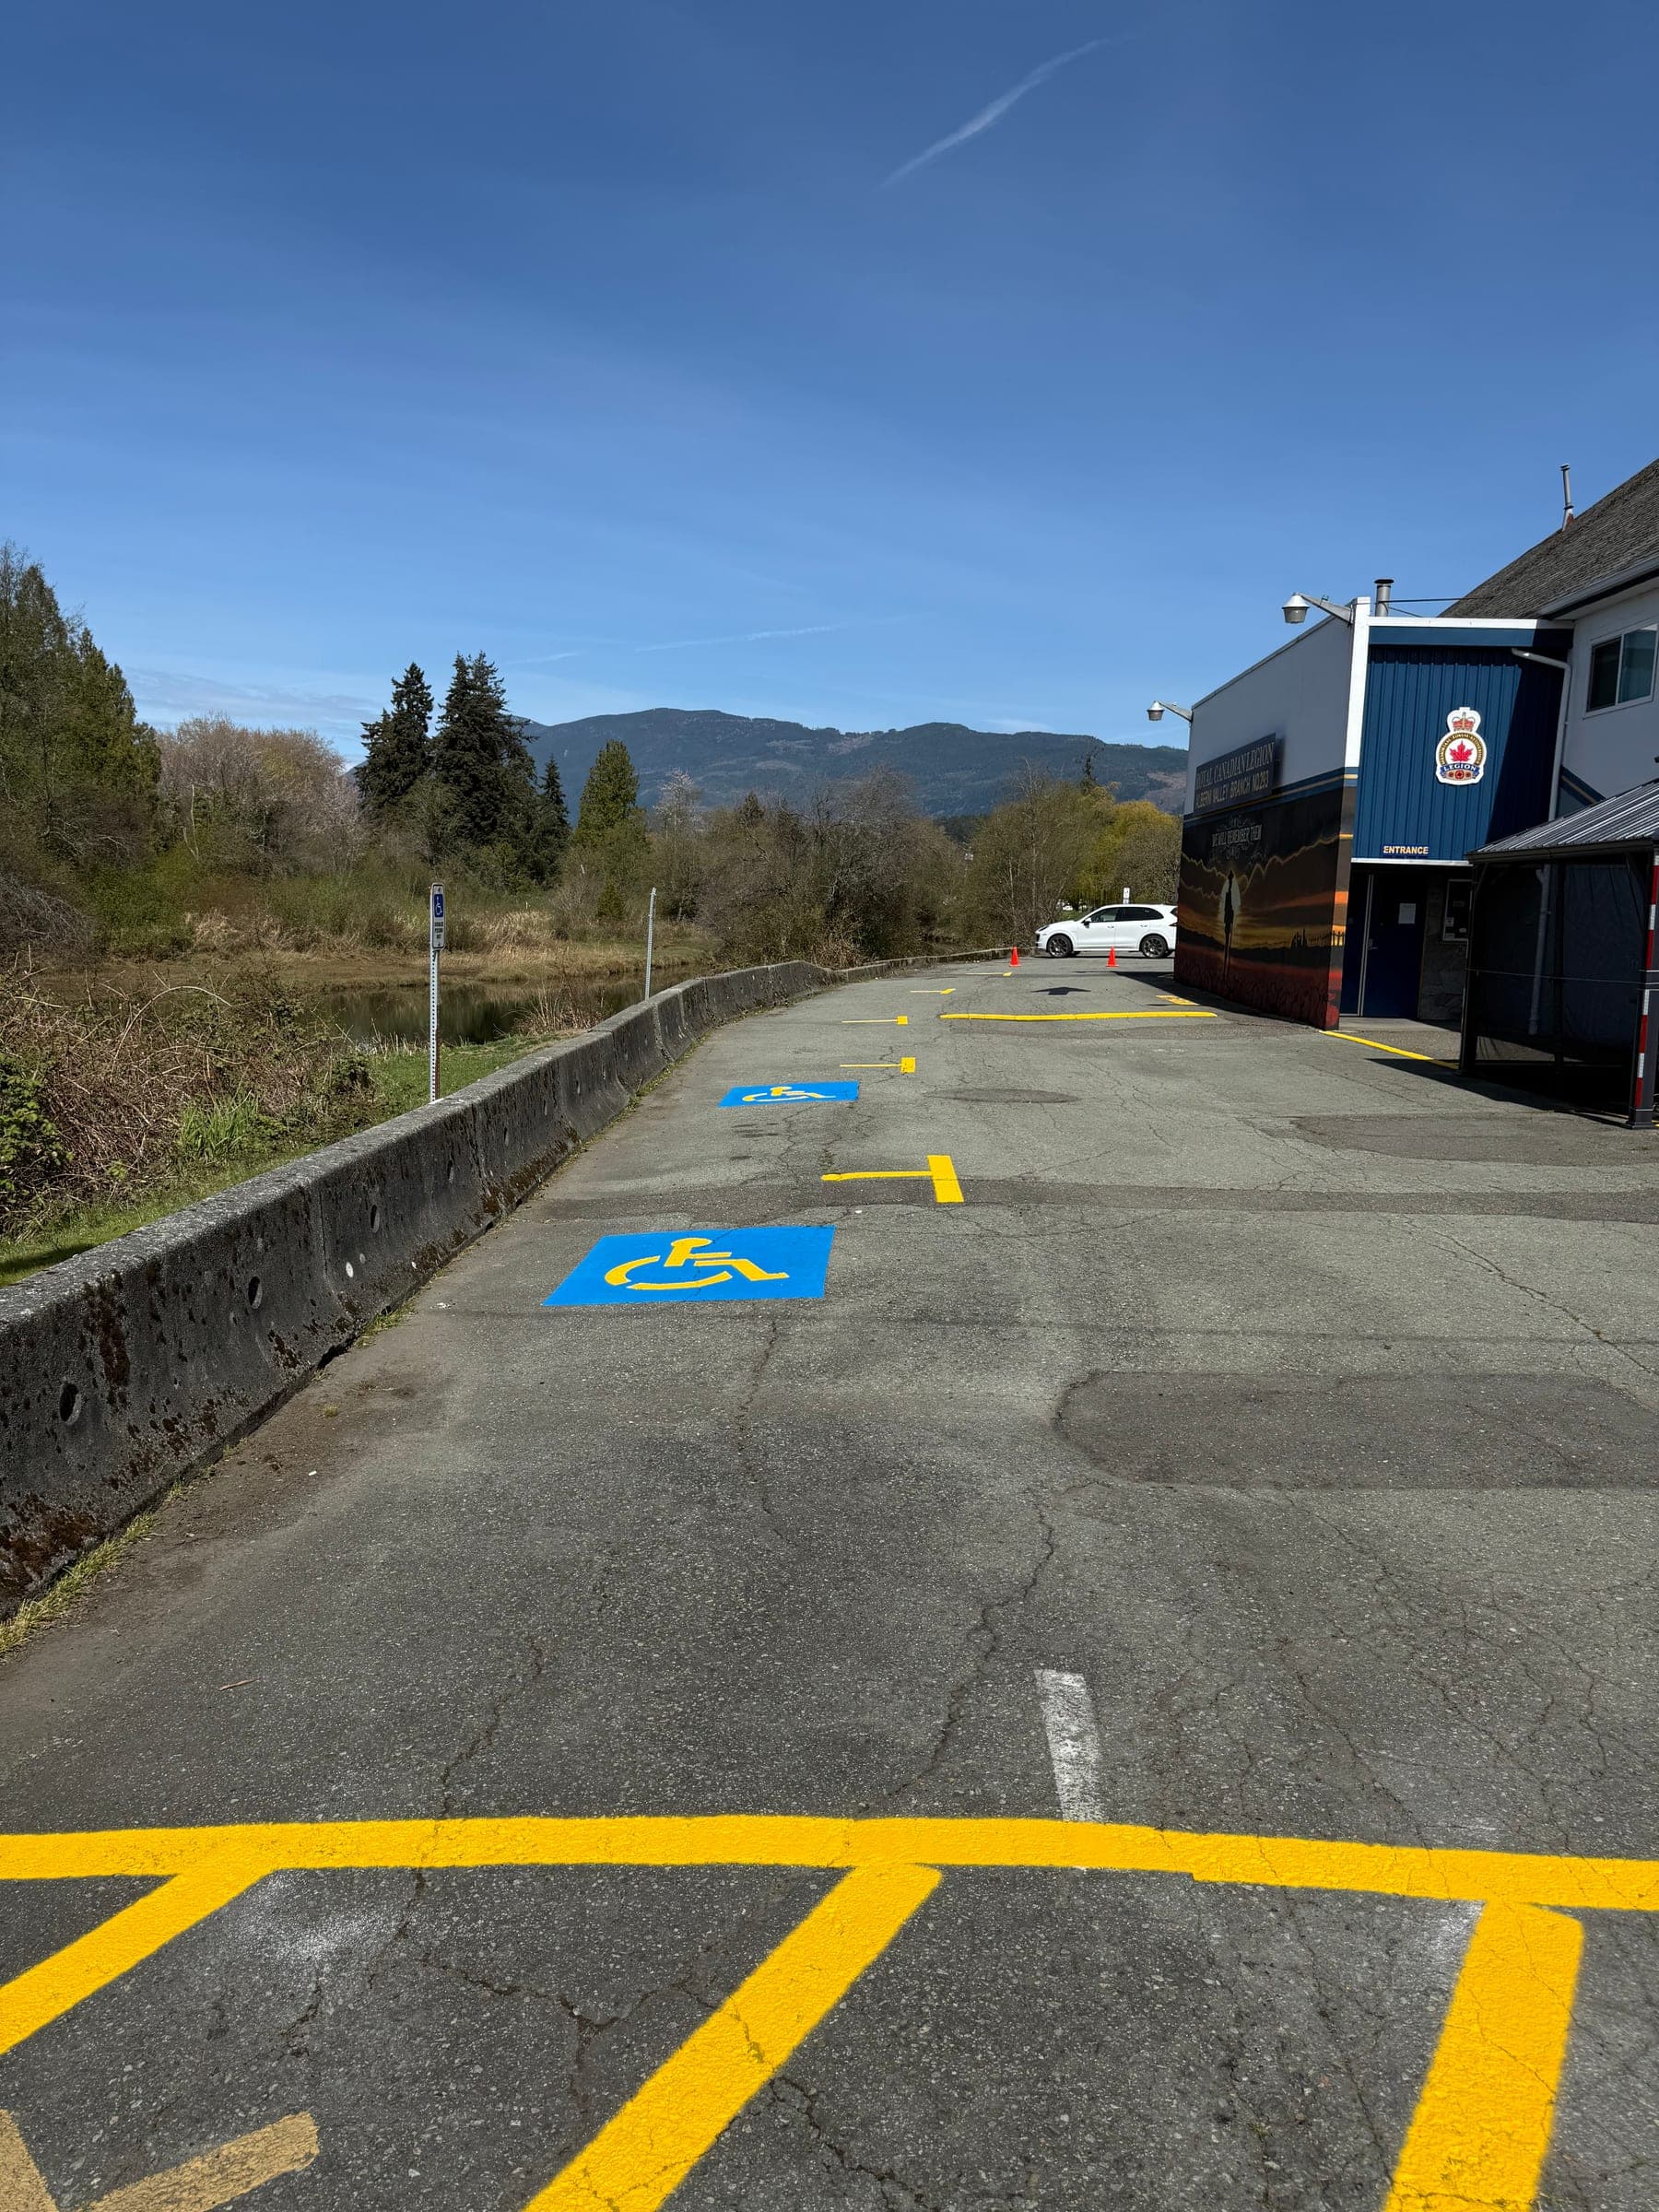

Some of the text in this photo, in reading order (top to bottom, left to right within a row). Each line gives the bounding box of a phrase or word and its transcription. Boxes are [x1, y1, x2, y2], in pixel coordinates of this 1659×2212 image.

[1214, 753, 1246, 782] CANADIAN
[1246, 742, 1275, 771] LEGION
[1213, 783, 1229, 803] VALLEY
[1230, 775, 1252, 798] BRANCH
[1382, 845, 1430, 854] ENTRANCE
